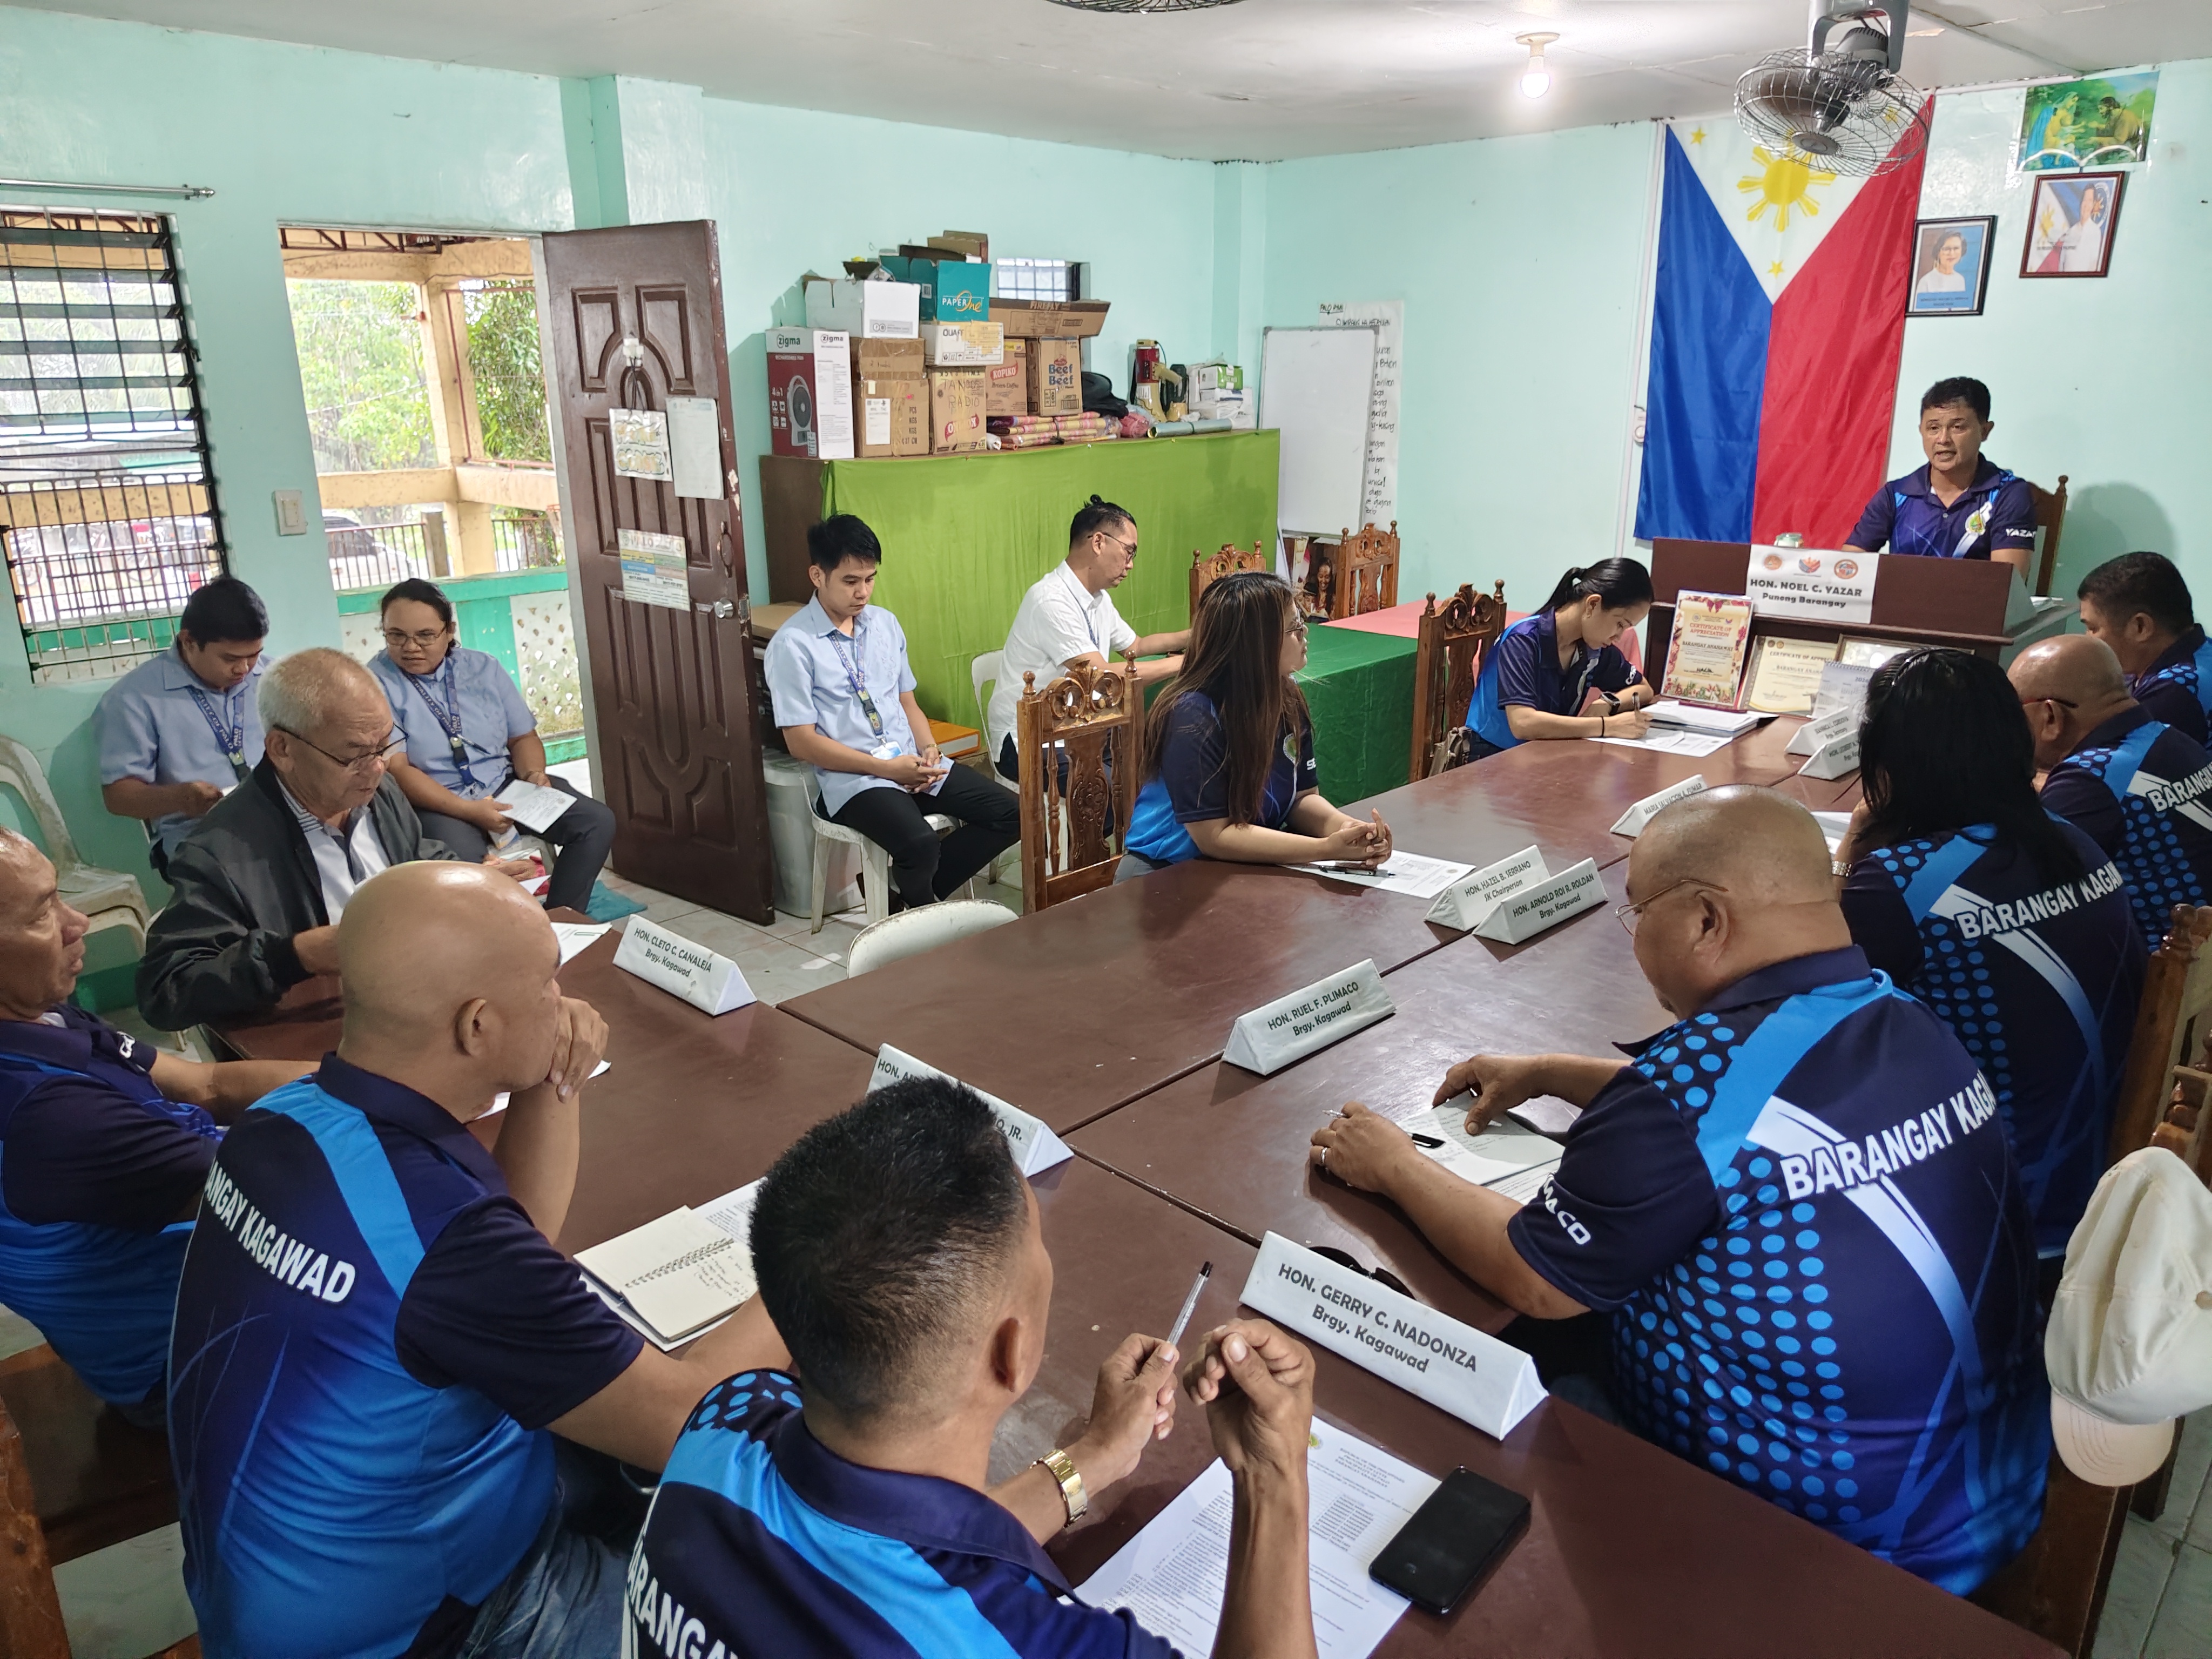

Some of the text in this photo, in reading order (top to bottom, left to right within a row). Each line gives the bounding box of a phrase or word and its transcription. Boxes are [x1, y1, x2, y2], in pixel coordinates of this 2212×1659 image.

[942, 290, 982, 312] PAPER One
[1030, 301, 1061, 311] FIREFLY
[993, 368, 1017, 379] KOPIKO
[1048, 363, 1073, 374] Beef
[1048, 375, 1074, 386] Beef
[909, 406, 918, 414] PCS
[949, 395, 980, 407] RADIO
[909, 416, 918, 424] KGS
[1750, 579, 1863, 596] HON. NOEL C. YAZAR
[1799, 596, 1846, 608] Barangay
[1690, 623, 1724, 631] CERTIFICATE
[1690, 628, 1729, 637] APPRECIATION
[1770, 651, 1800, 659] CERTIFICATE
[1643, 804, 1659, 815] MARIA
[1464, 860, 1531, 897] HON. HAZEL B. SERRANO
[1484, 879, 1523, 902] SK Chairperson
[1513, 873, 1595, 918] HON. ARNOLD ROI R. ROLDAN
[1539, 892, 1582, 919] Brgy. Kagawad
[1956, 881, 2080, 939] BARANGAY
[633, 928, 712, 973] HON. CLETO C. CANALEJA
[645, 948, 692, 977] Brgy. Kagawad
[1267, 981, 1360, 1030] HON. RUEL F. PLIMACO
[1292, 1001, 1352, 1036] Brgy. Kagawad
[877, 1058, 900, 1080] HON.
[1007, 1123, 1022, 1141] JR.
[1779, 1102, 1953, 1201] BARANGAY
[238, 1205, 356, 1303] KAGAWAD
[1277, 1262, 1477, 1372] HON. GERRY C. NADONZA
[1311, 1303, 1431, 1373] Brgy. Kagawad
